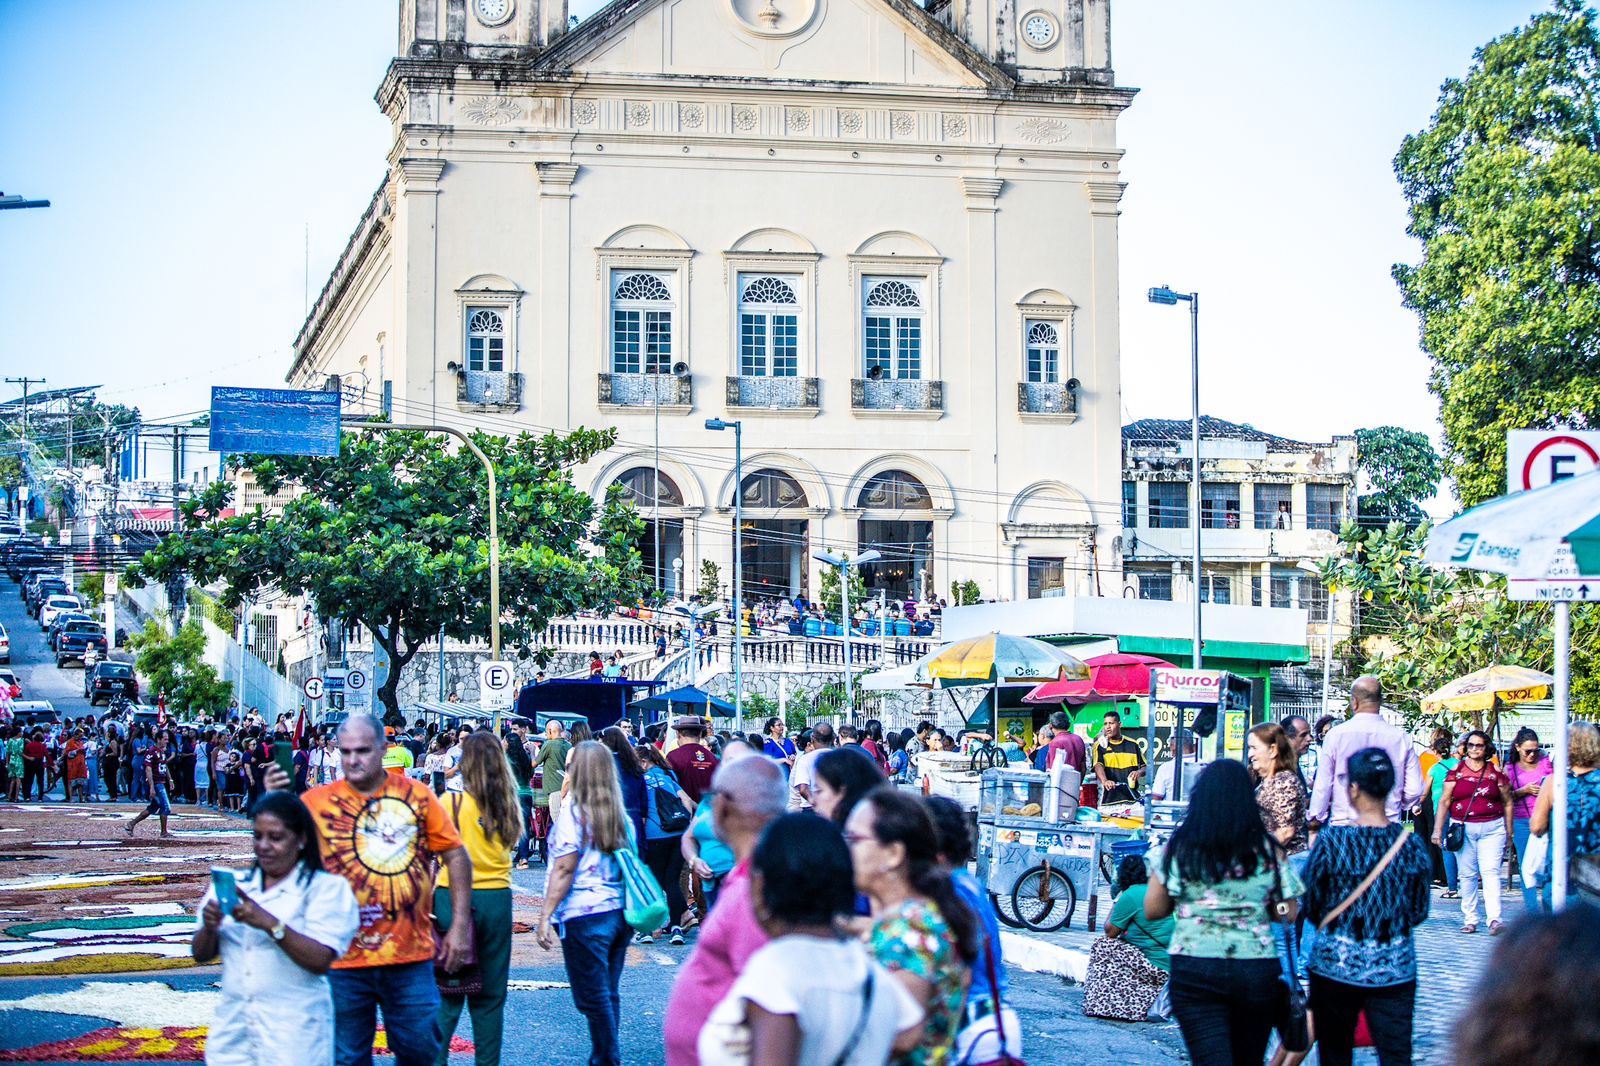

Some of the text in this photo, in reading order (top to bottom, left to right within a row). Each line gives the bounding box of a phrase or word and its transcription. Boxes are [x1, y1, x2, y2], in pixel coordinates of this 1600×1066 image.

[352, 675, 360, 685] E
[491, 669, 502, 686] E
[1156, 672, 1220, 688] Churros
[1507, 689, 1534, 701] SKOL
